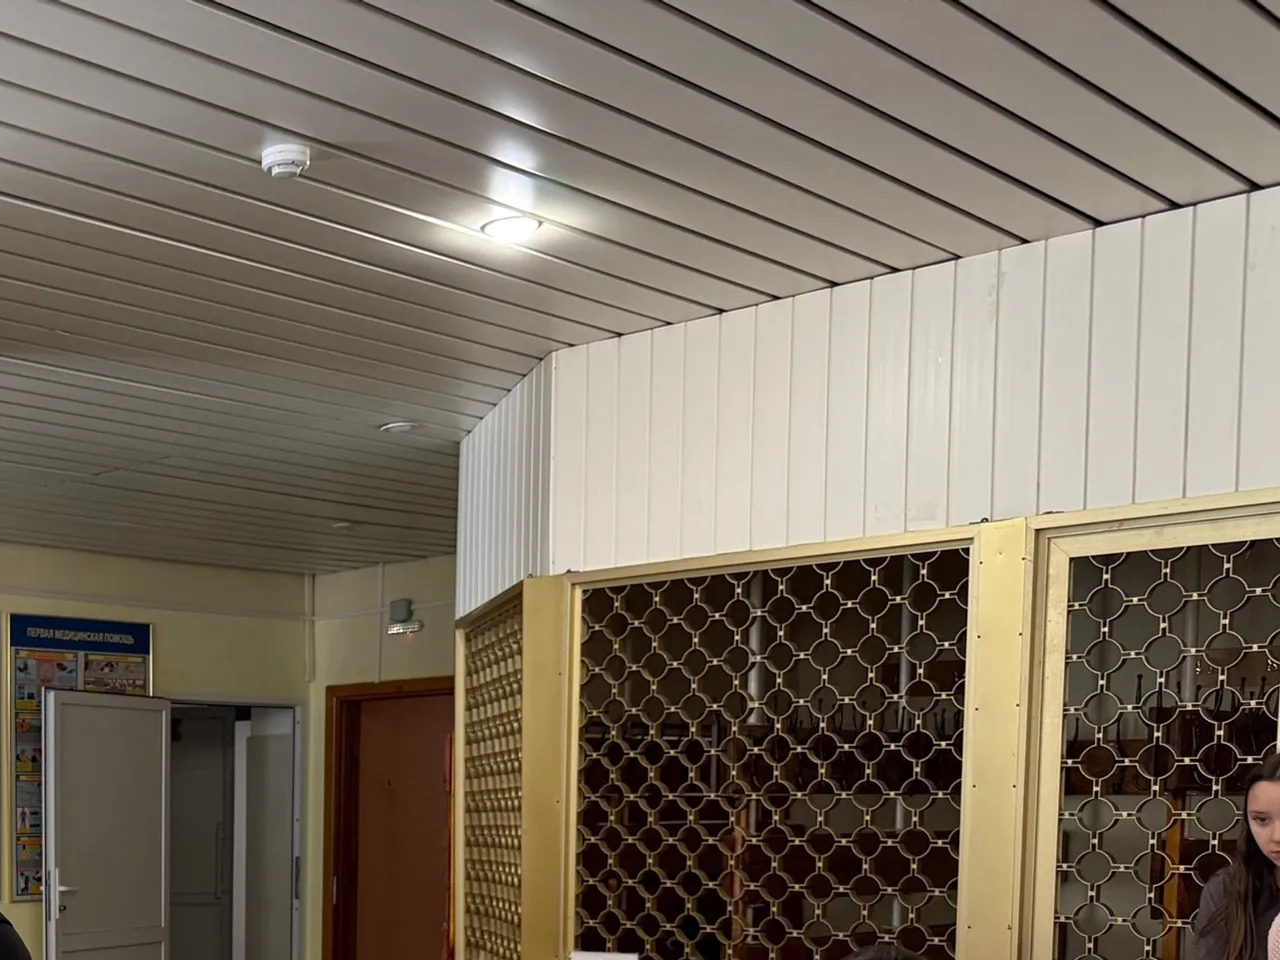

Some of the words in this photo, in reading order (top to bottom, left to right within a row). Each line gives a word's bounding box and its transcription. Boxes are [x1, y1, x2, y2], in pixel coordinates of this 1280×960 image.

[27, 627, 54, 638] ПЕРВАЯ
[55, 629, 104, 642] МЕДИЦИНСКАЯ
[104, 633, 134, 645] ПОМОЩЬ
